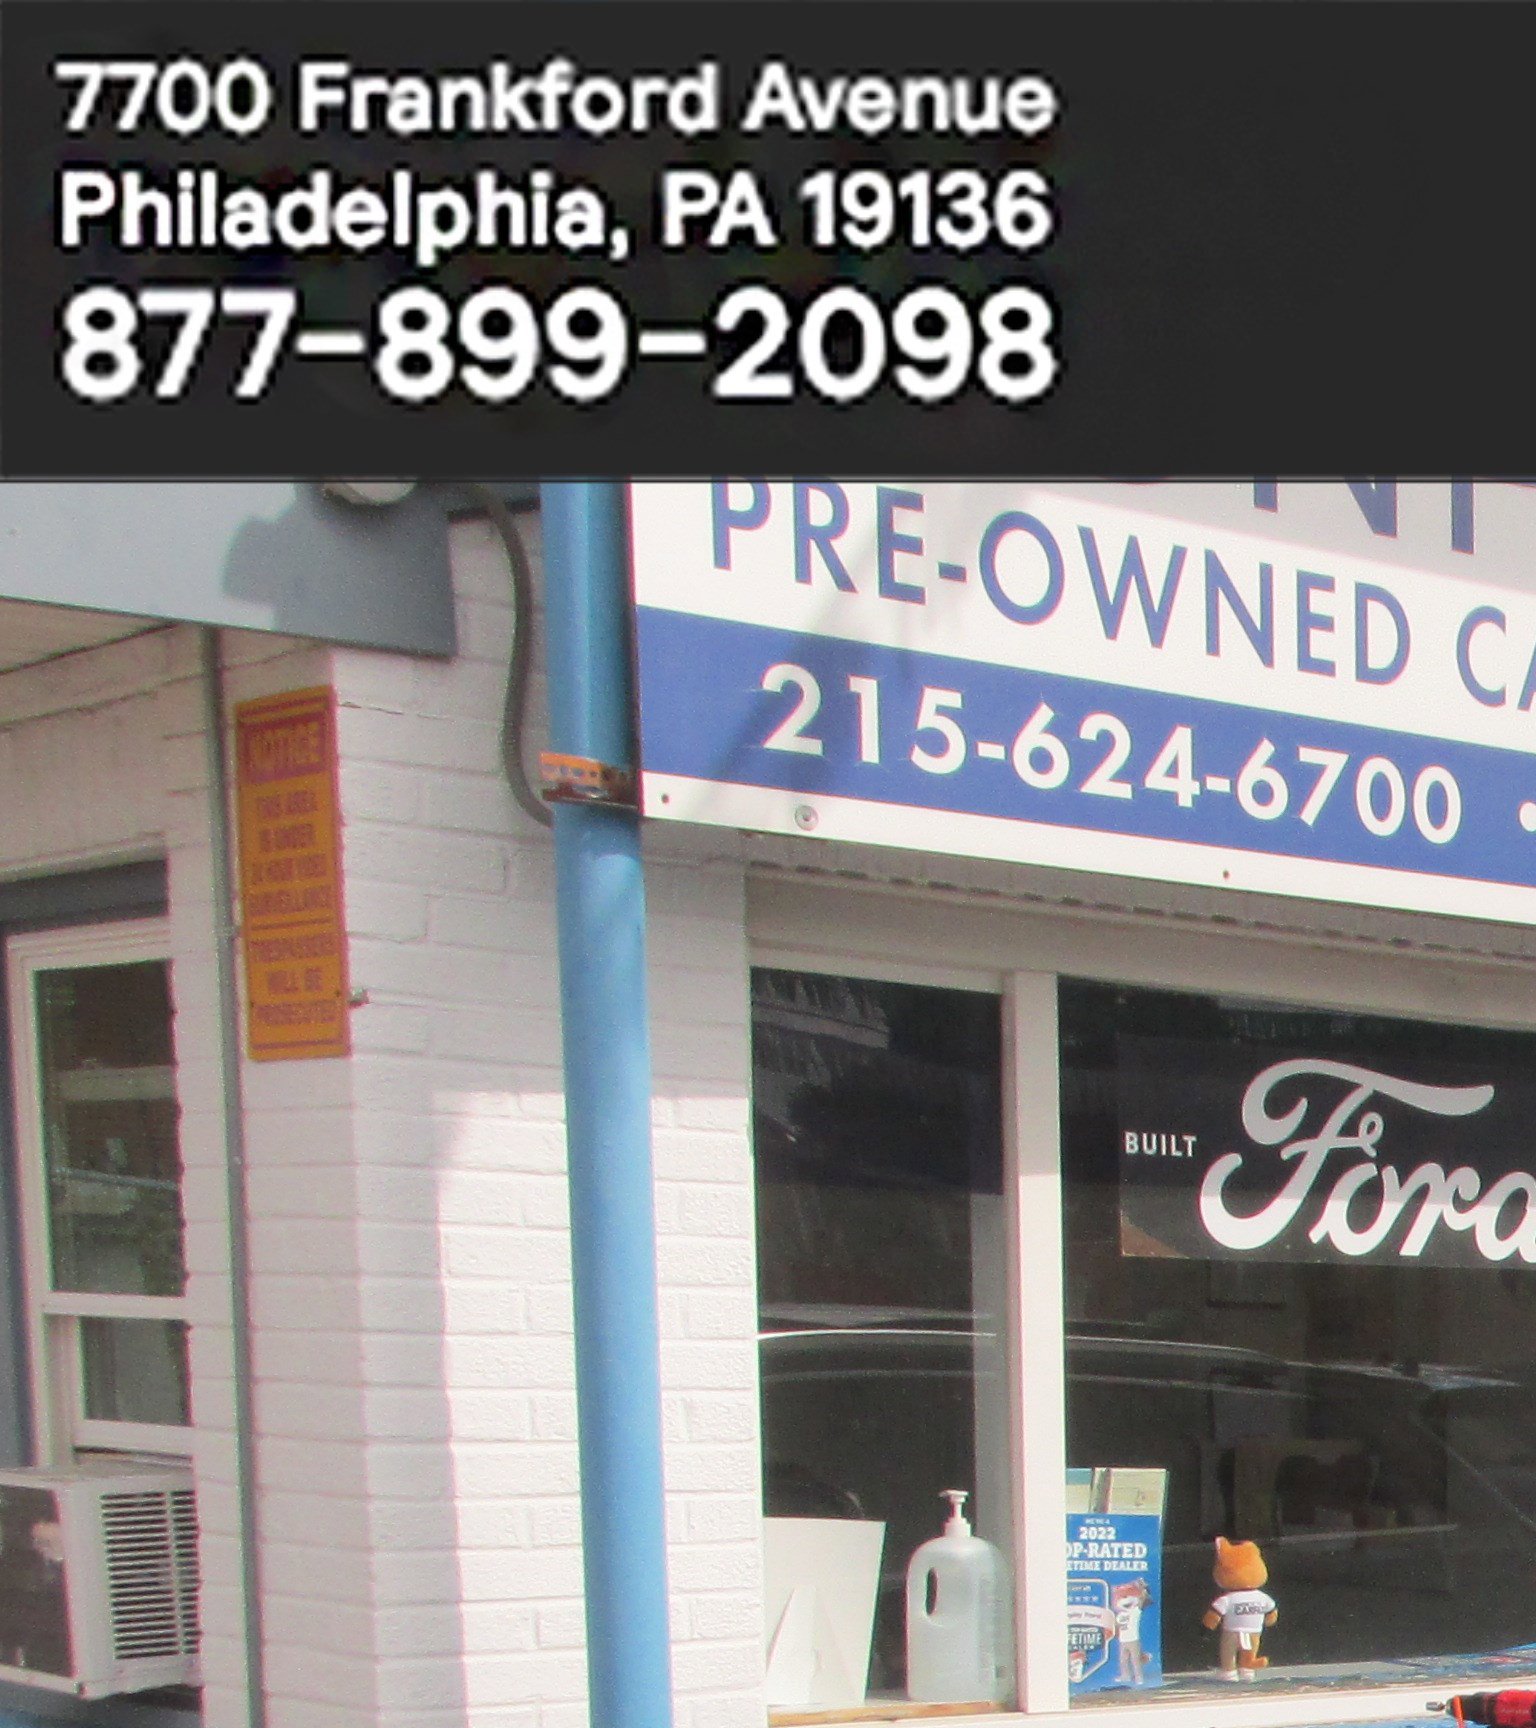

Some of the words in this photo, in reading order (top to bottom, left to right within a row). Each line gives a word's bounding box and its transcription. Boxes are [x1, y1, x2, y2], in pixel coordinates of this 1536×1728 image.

[709, 478, 1412, 688] PRE-OWNED
[761, 661, 1463, 846] 215-624-6700
[1124, 1131, 1198, 1158] BUILT
[1078, 1526, 1117, 1540] 2022
[1066, 1541, 1148, 1559] OP-RATED
